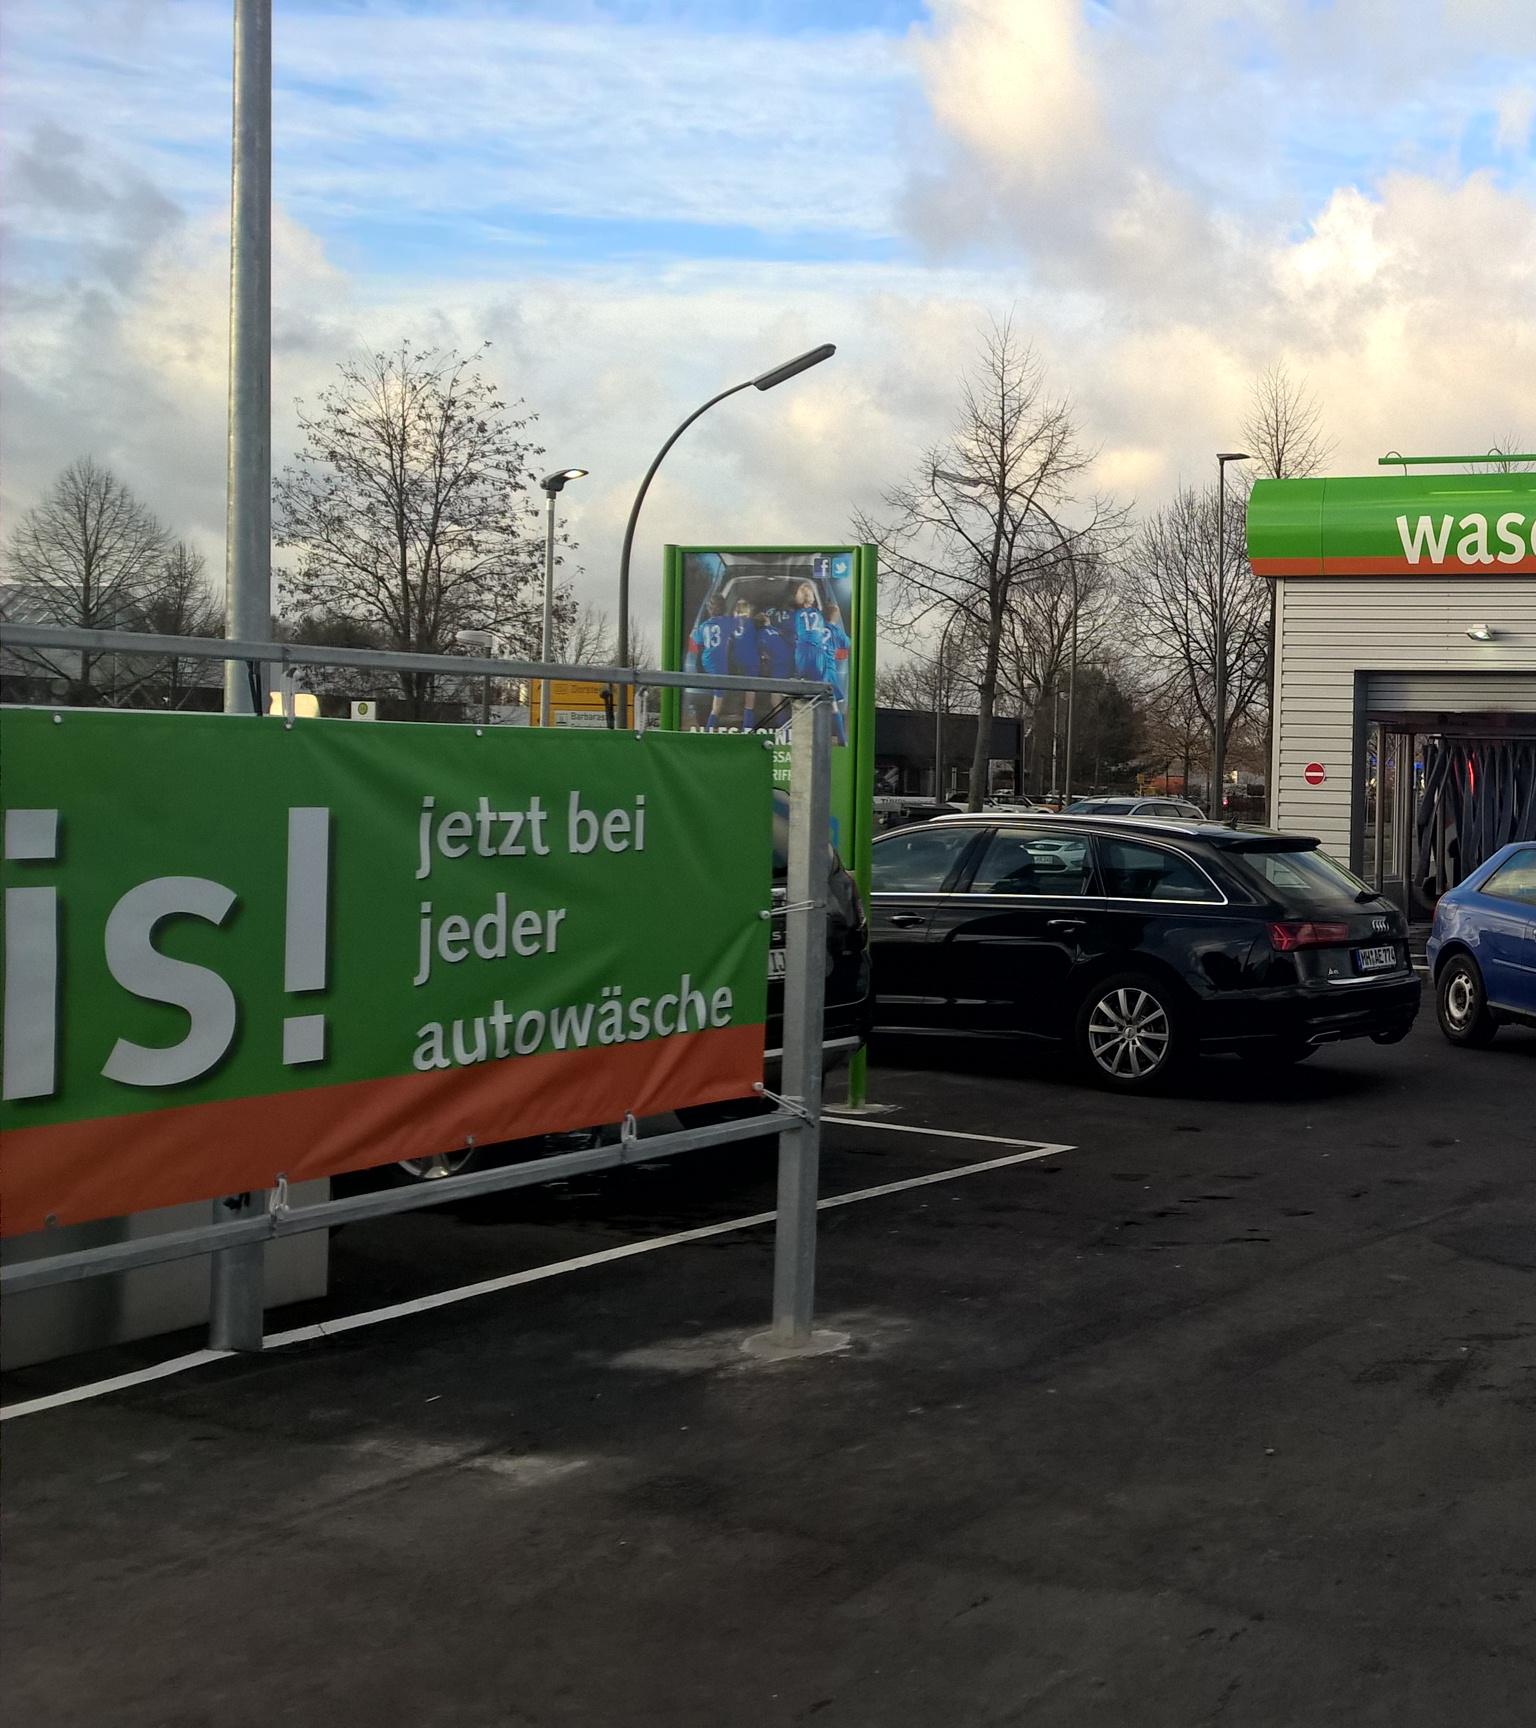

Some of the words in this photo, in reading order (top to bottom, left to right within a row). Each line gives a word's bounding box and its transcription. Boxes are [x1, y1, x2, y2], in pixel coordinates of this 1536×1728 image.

[703, 624, 721, 648] 13
[415, 795, 551, 879] jetzt
[567, 790, 646, 855] bei
[413, 892, 567, 987] jeder
[412, 973, 734, 1072] autowäsche
